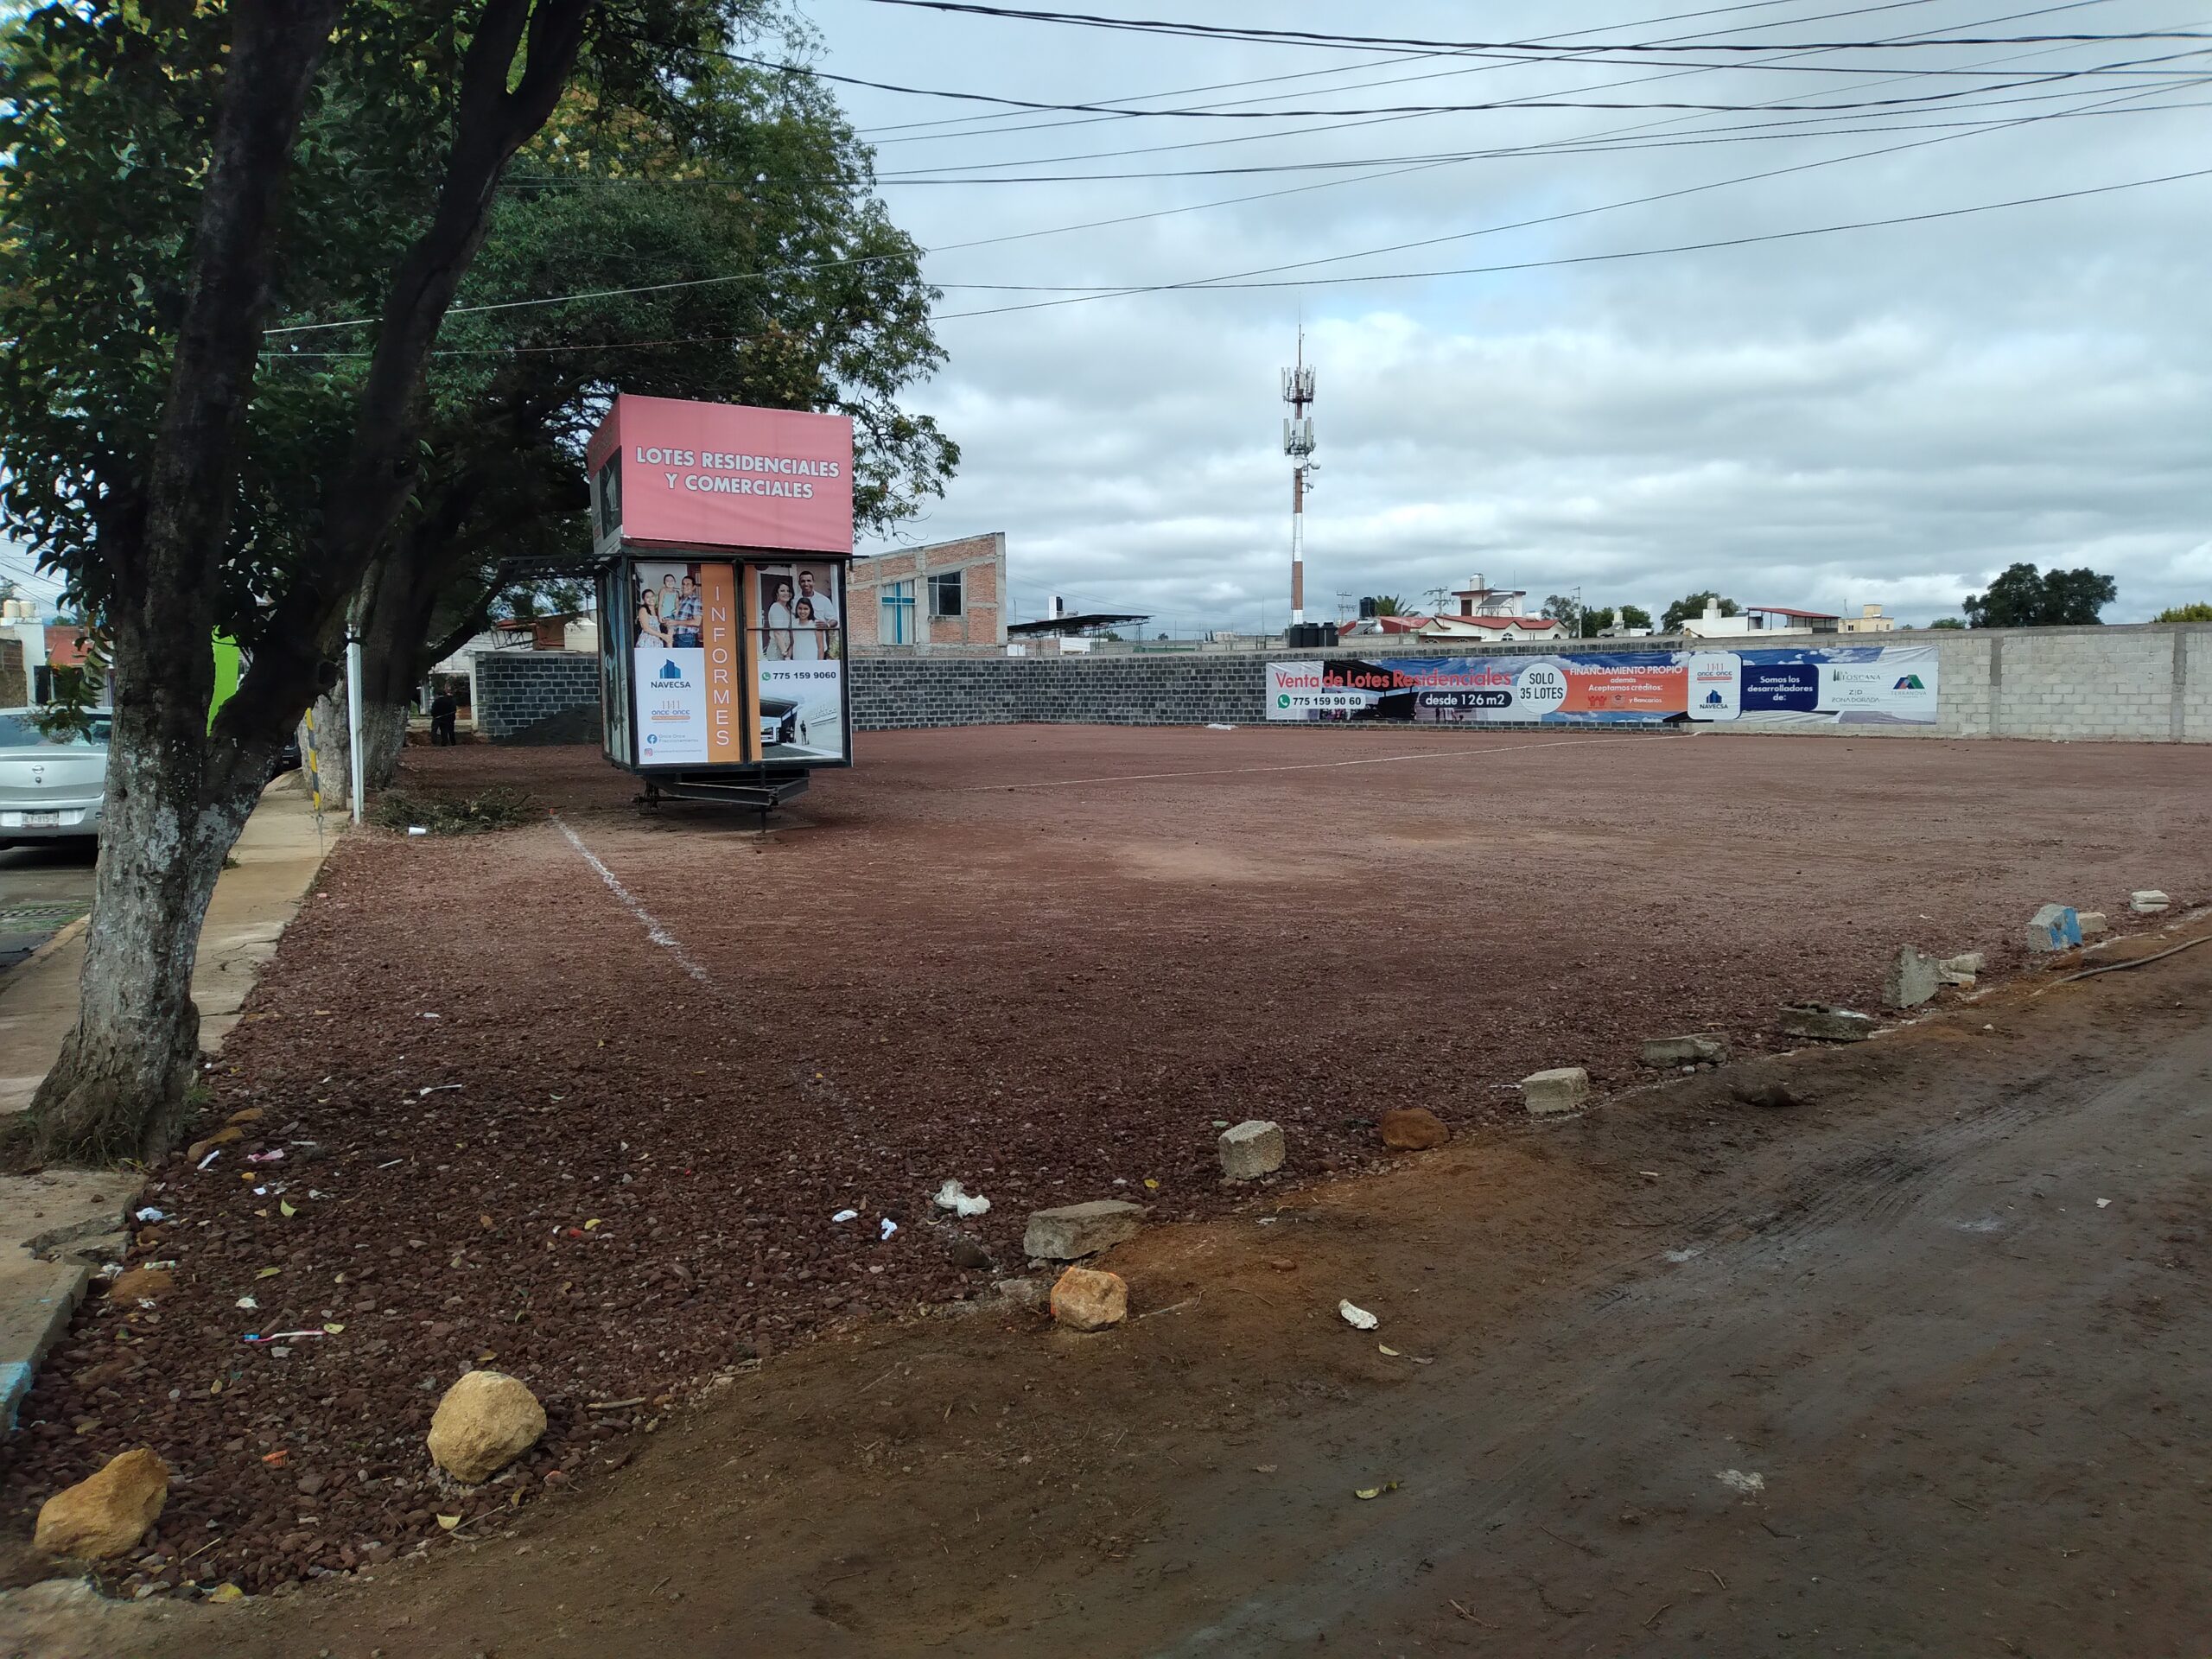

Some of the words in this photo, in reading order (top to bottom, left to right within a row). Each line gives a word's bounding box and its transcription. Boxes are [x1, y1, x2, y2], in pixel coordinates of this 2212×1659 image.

[636, 447, 695, 467] LOTES
[702, 451, 840, 478] RESIDENCIALES
[664, 473, 678, 489] Y
[684, 474, 814, 499] COMERCIALES
[710, 585, 731, 747] INFORMES
[1569, 666, 1646, 676] FINANCIAMIENTO
[1647, 665, 1683, 674] PROPIO
[813, 671, 836, 679] 9060
[1275, 672, 1319, 689] Venta
[1322, 669, 1344, 688] de
[1346, 670, 1389, 688] Lotes
[1393, 666, 1511, 688] Residenciales
[1529, 672, 1554, 685] SOLO
[1788, 675, 1801, 683] los
[1520, 687, 1531, 700] 35
[1534, 687, 1564, 699] LOTES
[1747, 684, 1814, 693] desarrolladores
[1293, 696, 1310, 706] 775
[1313, 696, 1331, 706] 159
[1333, 696, 1346, 706] 90
[1349, 696, 1362, 706] 60
[1425, 694, 1459, 706] desde
[1461, 694, 1484, 706] 126
[1486, 694, 1505, 706] m2
[1772, 693, 1787, 702] de:
